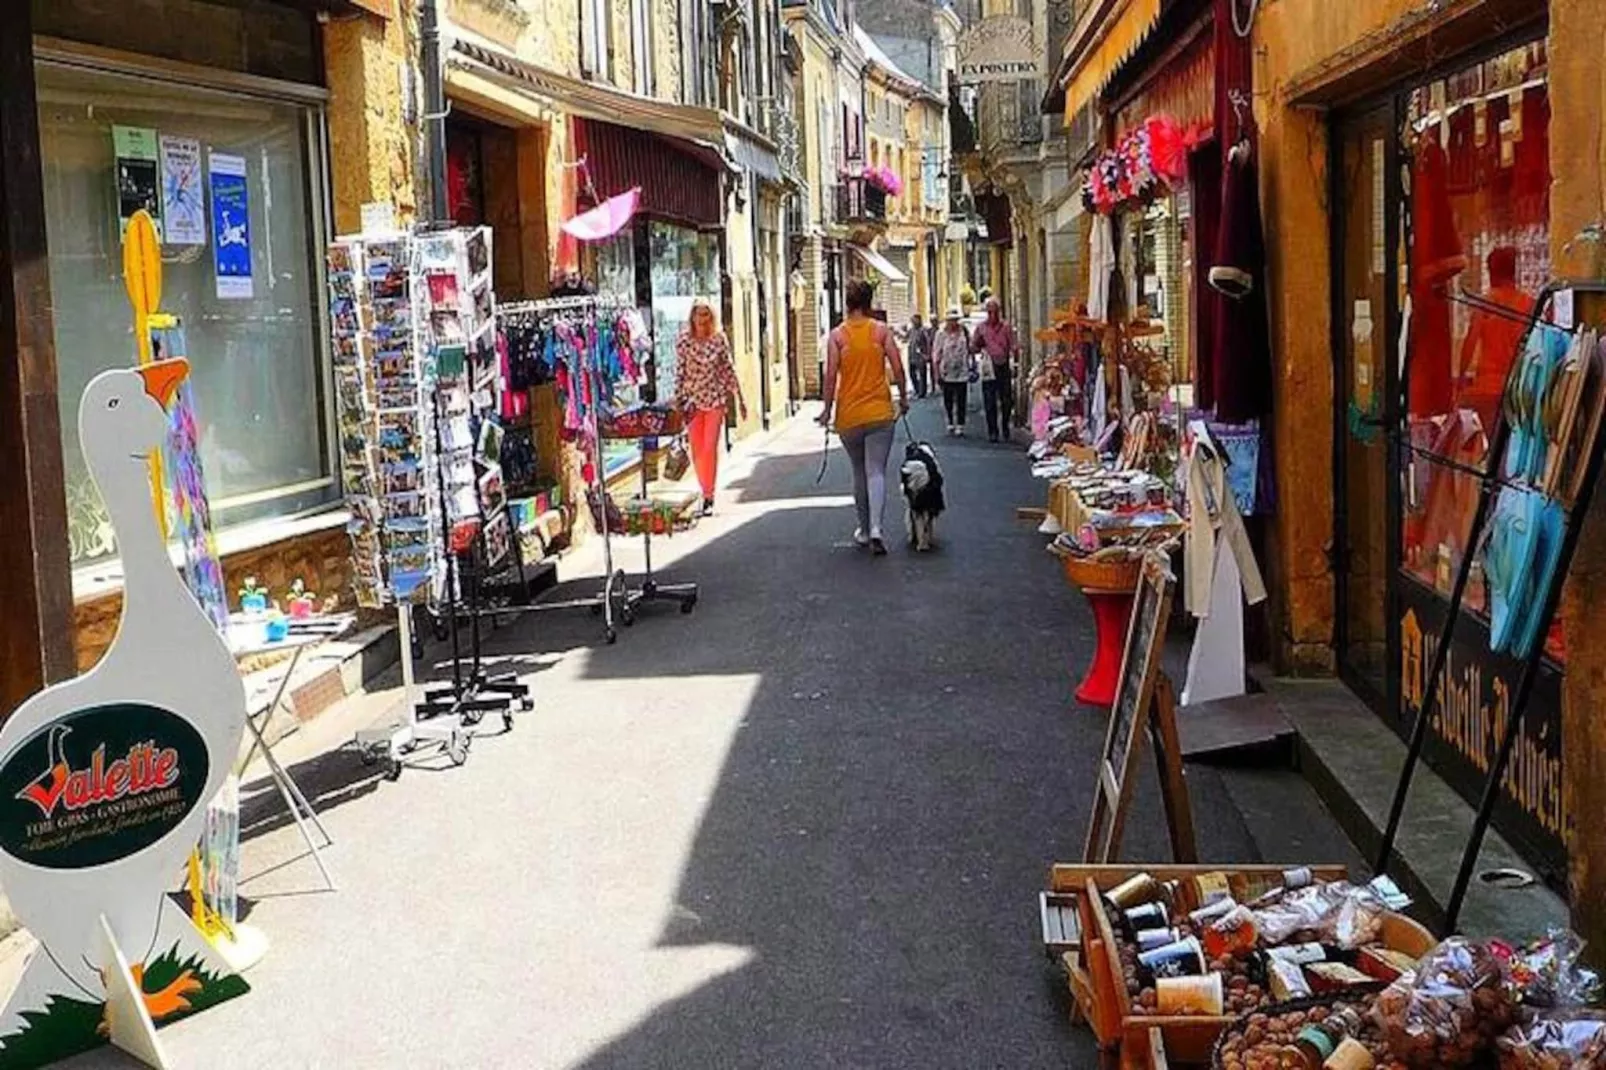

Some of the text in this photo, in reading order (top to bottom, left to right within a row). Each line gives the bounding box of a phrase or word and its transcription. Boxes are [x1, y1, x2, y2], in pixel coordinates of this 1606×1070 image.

[960, 61, 1038, 75] EXPOSITION
[17, 739, 180, 818] Valette
[56, 811, 91, 832] GRAS
